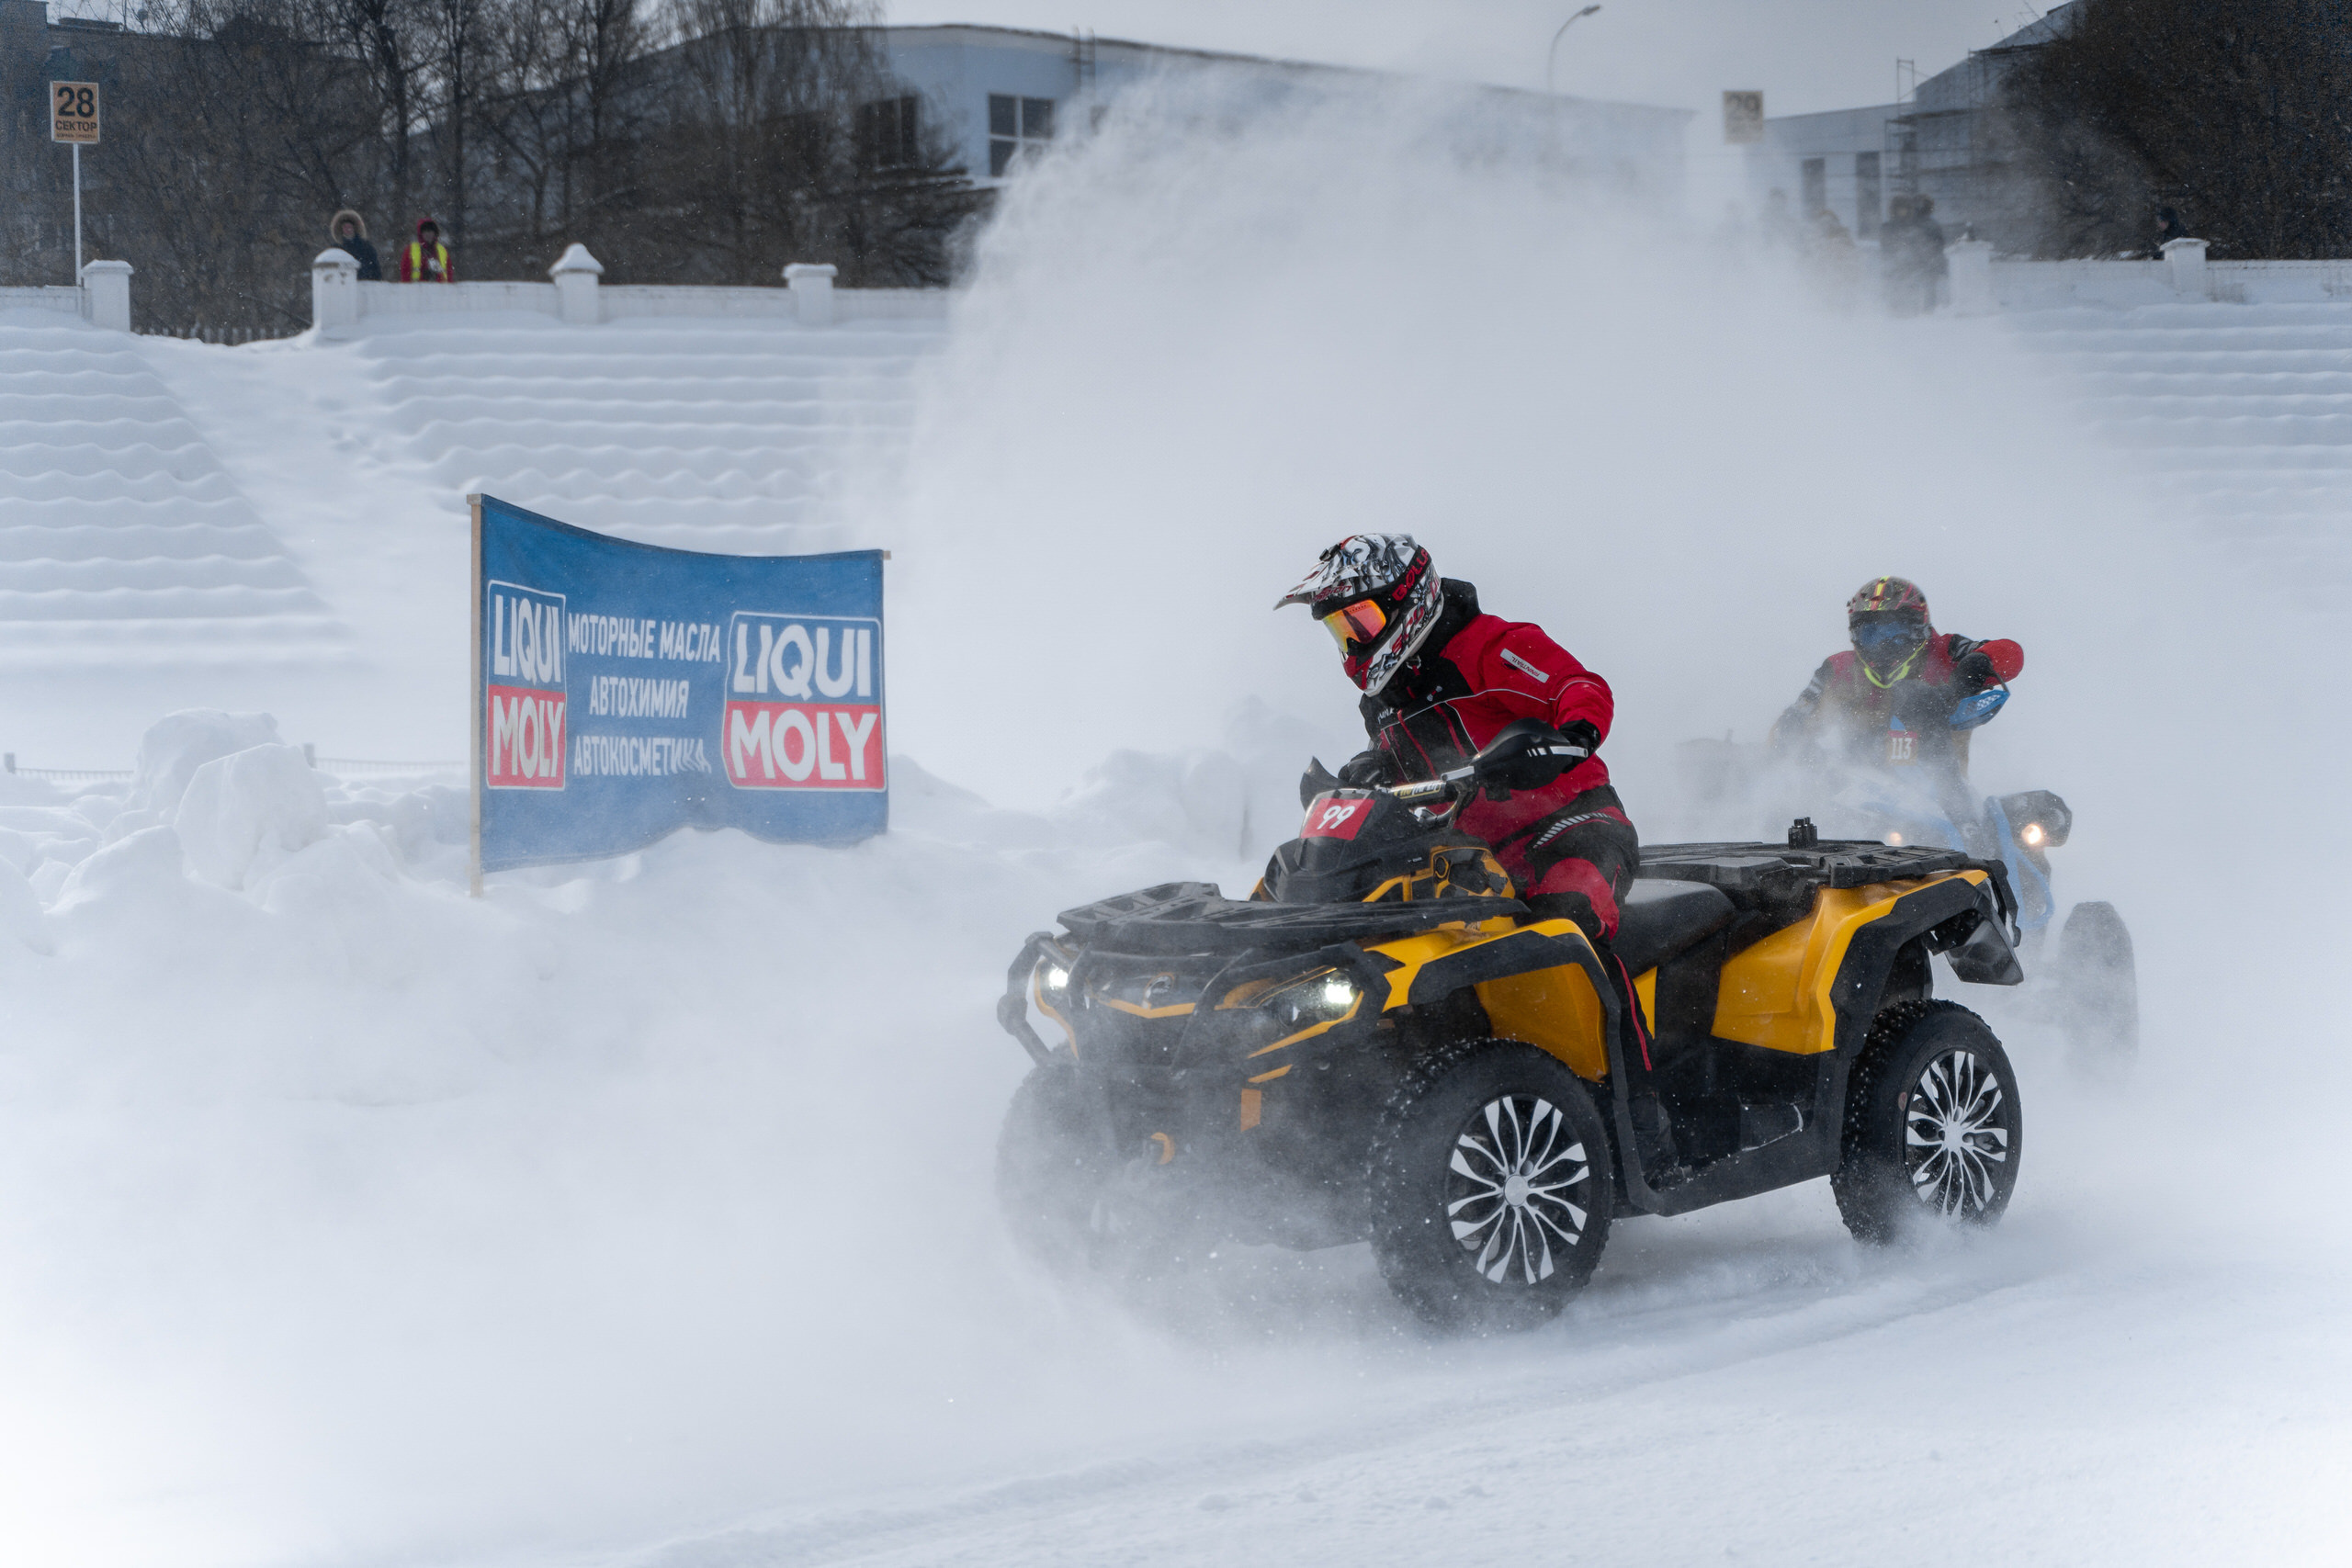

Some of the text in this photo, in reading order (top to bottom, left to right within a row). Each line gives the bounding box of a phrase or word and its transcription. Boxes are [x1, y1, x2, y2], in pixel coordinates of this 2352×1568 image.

[58, 86, 95, 118] 28
[55, 120, 96, 131] СЕКТОР
[494, 595, 561, 684] LIQUI
[568, 614, 720, 662] МОТОРНЫЕ МАСЛА
[734, 624, 871, 700] LIQUI
[589, 676, 689, 718] АВТОХИМИЯ
[493, 696, 564, 778] MOLY
[573, 736, 712, 775] АВТОКОСМЕТИКА
[731, 710, 878, 781] MOLY
[1891, 738, 1912, 759] 113
[1317, 806, 1355, 829] 99
